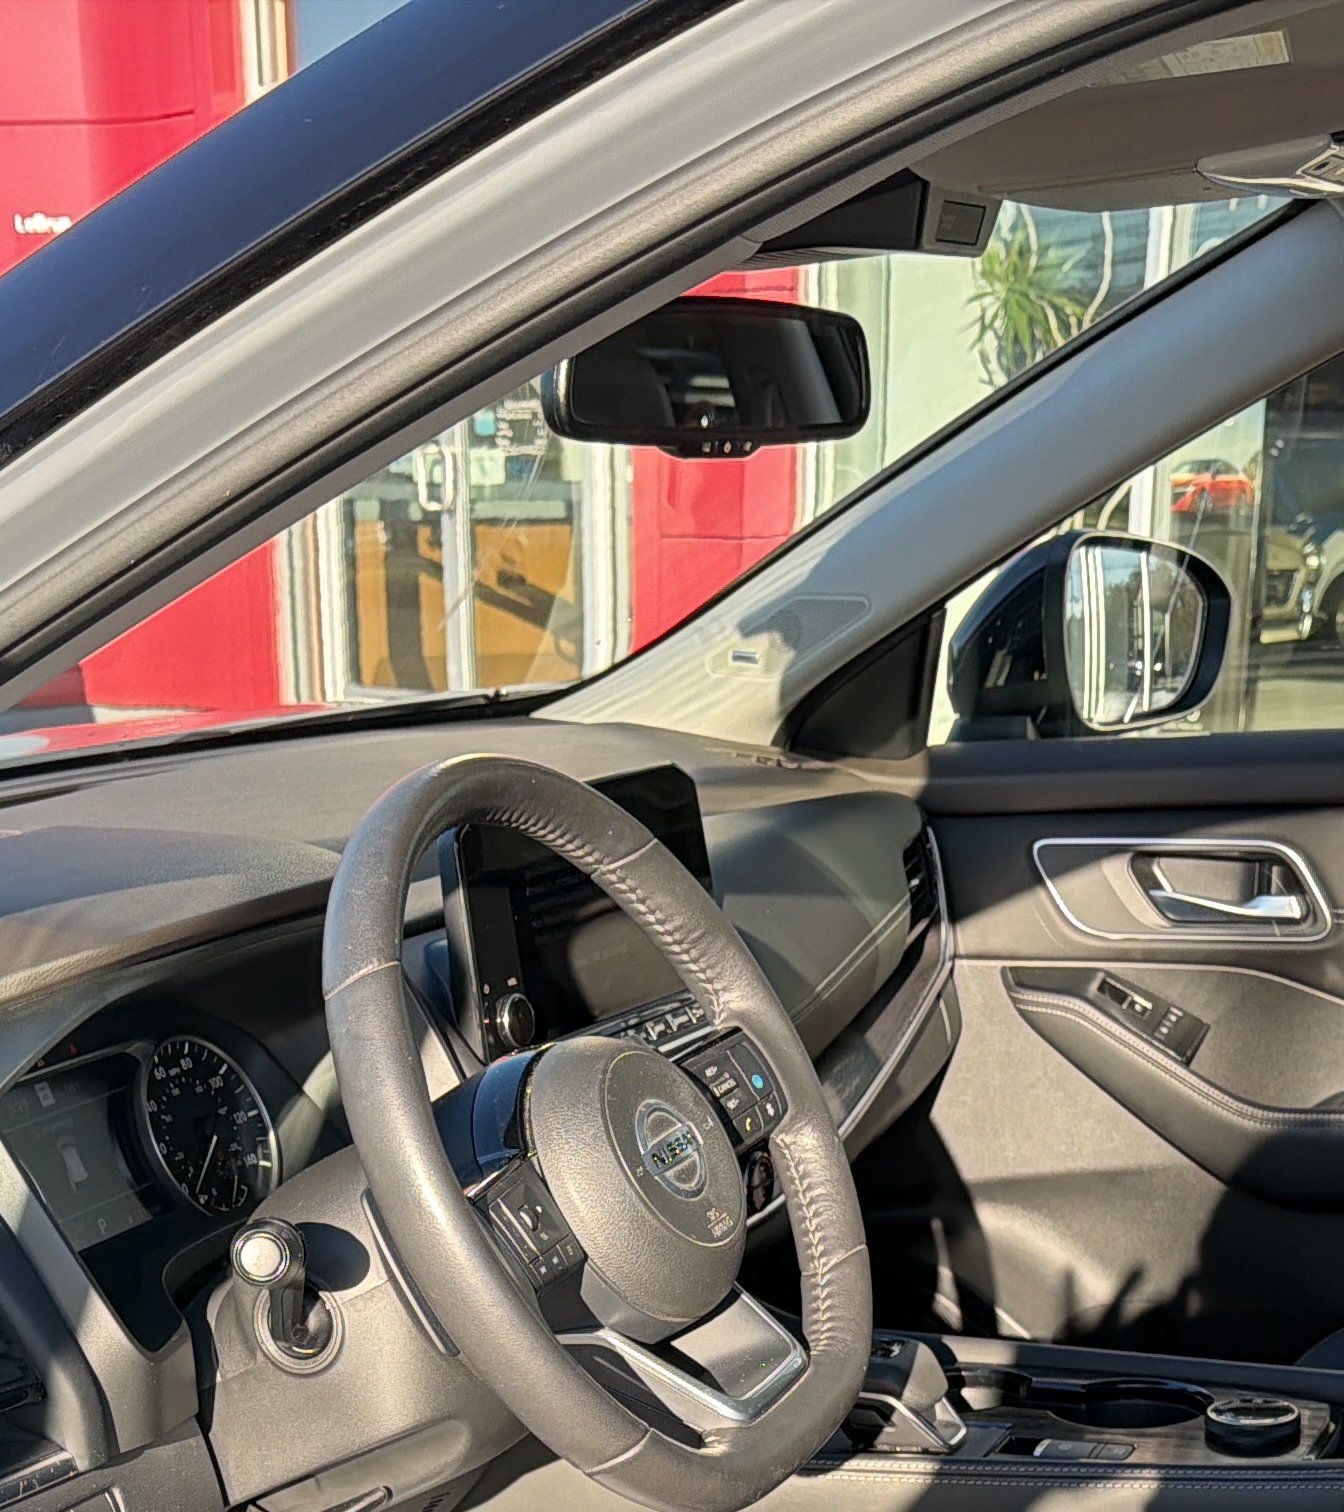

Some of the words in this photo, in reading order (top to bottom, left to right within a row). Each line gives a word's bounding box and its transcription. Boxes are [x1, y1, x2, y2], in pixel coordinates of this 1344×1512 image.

[180, 1056, 193, 1070] 80
[154, 1066, 166, 1080] 60
[208, 1075, 224, 1089] 100
[233, 1110, 248, 1124] 120
